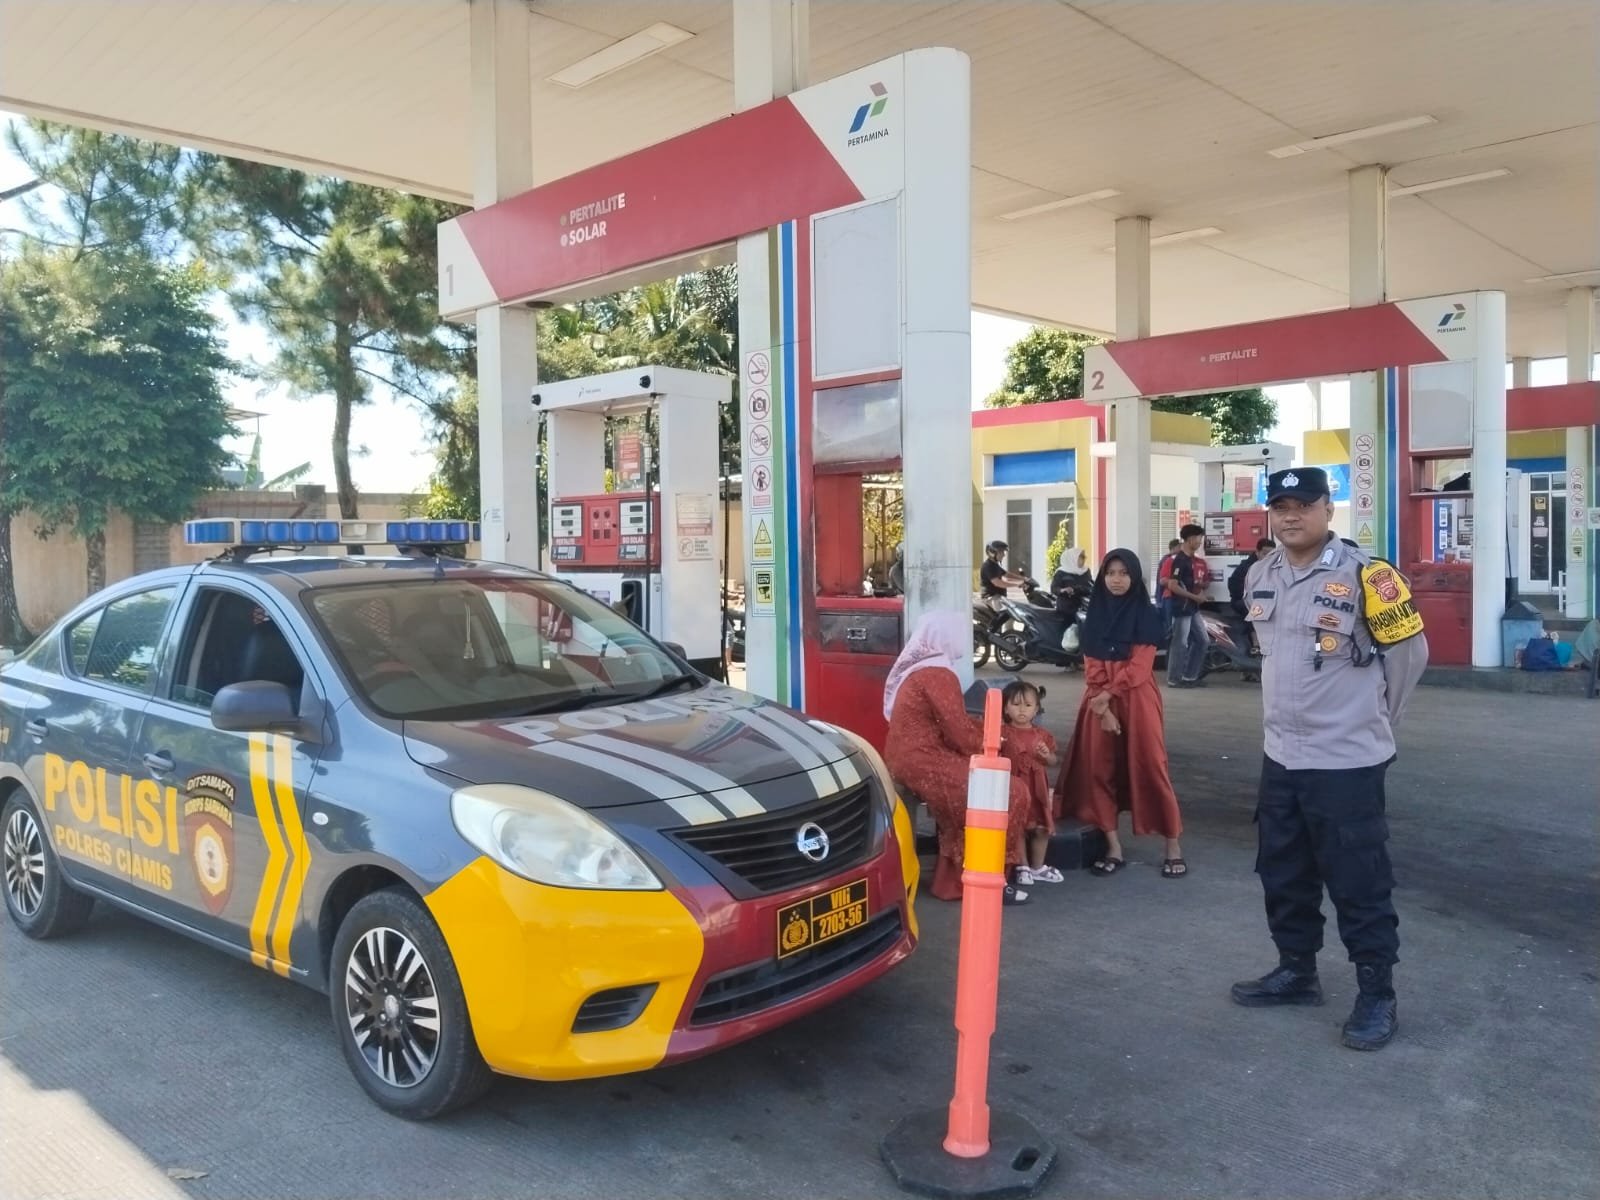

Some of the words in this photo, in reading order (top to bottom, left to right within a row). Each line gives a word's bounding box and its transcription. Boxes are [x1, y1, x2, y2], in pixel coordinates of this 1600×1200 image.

[847, 128, 889, 147] PERTAMINA
[569, 192, 626, 225] PERTALITE
[569, 220, 607, 246] SOLAR
[445, 263, 454, 297] 1
[1209, 348, 1258, 362] PERTALITE
[1091, 370, 1105, 391] 2
[1314, 595, 1355, 613] POLRI
[186, 774, 234, 801] DITSAMAPTA
[44, 751, 180, 855] POLISI
[55, 824, 112, 866] POLRES
[115, 847, 172, 891] CIAMIS
[819, 904, 863, 938] 2703-56
